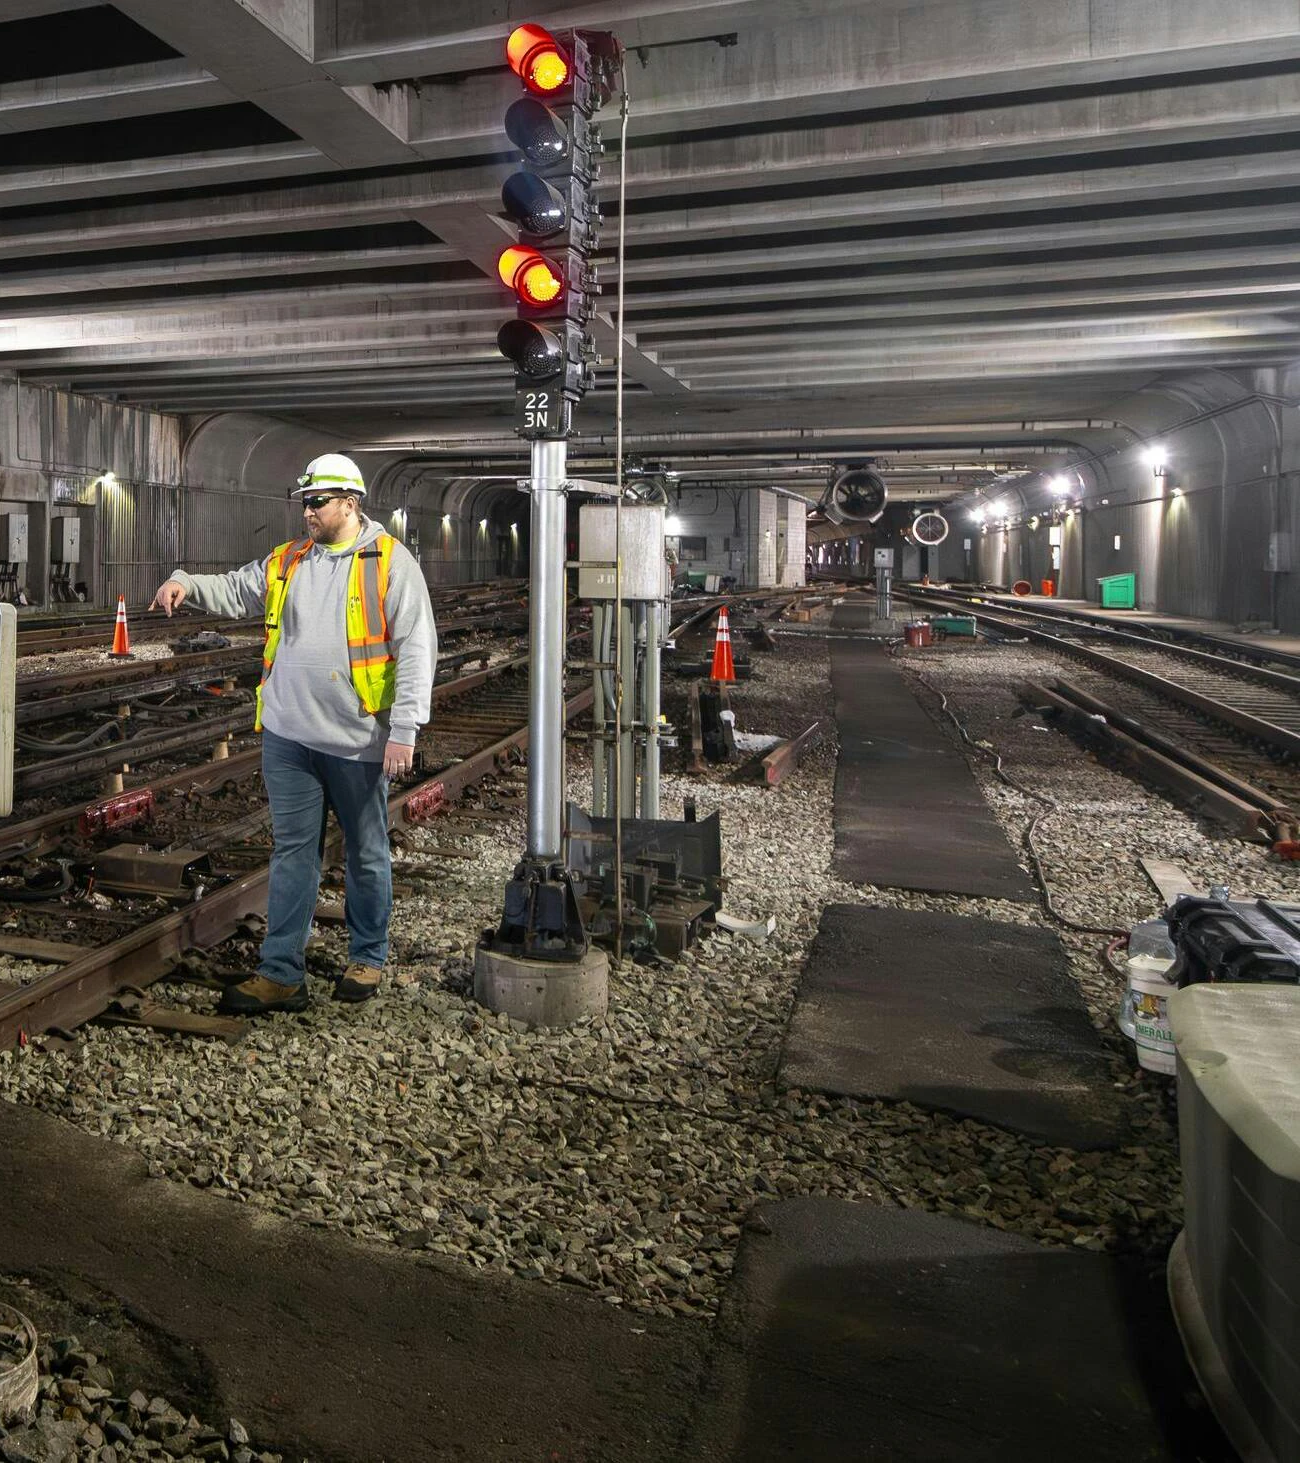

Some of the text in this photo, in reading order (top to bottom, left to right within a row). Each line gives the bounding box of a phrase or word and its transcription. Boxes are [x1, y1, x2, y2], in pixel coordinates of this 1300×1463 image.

[525, 392, 549, 409] 22
[524, 411, 548, 428] 3N
[1135, 1023, 1176, 1041] MERAL
